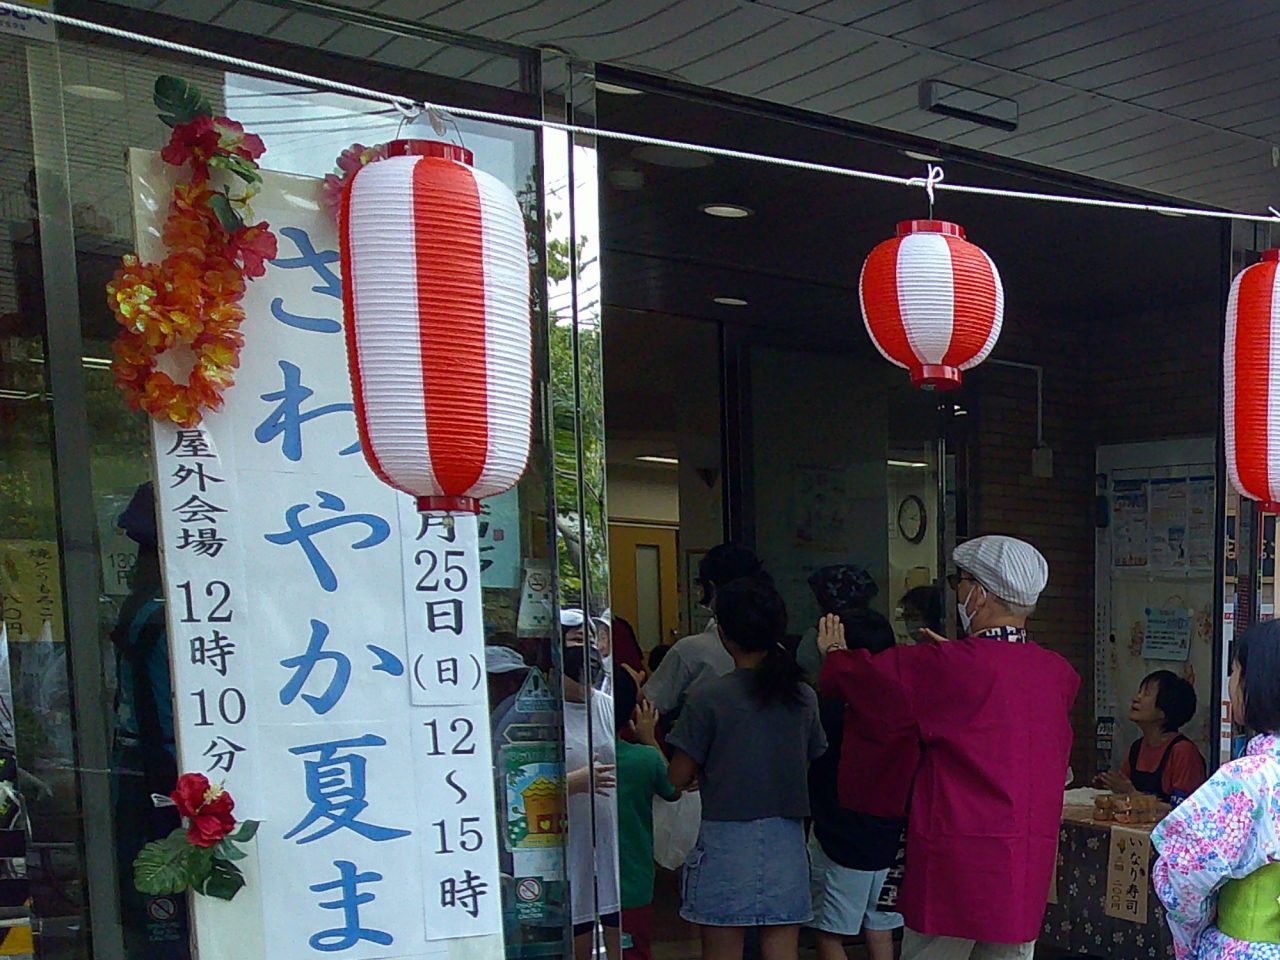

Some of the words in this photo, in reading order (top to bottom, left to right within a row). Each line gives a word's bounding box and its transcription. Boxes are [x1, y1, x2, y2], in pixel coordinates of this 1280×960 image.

[165, 429, 229, 558] 屋外会場
[176, 579, 247, 773] 12時10分
[413, 512, 482, 690] 月25日(日)
[1126, 837, 1143, 915] いなり寿司
